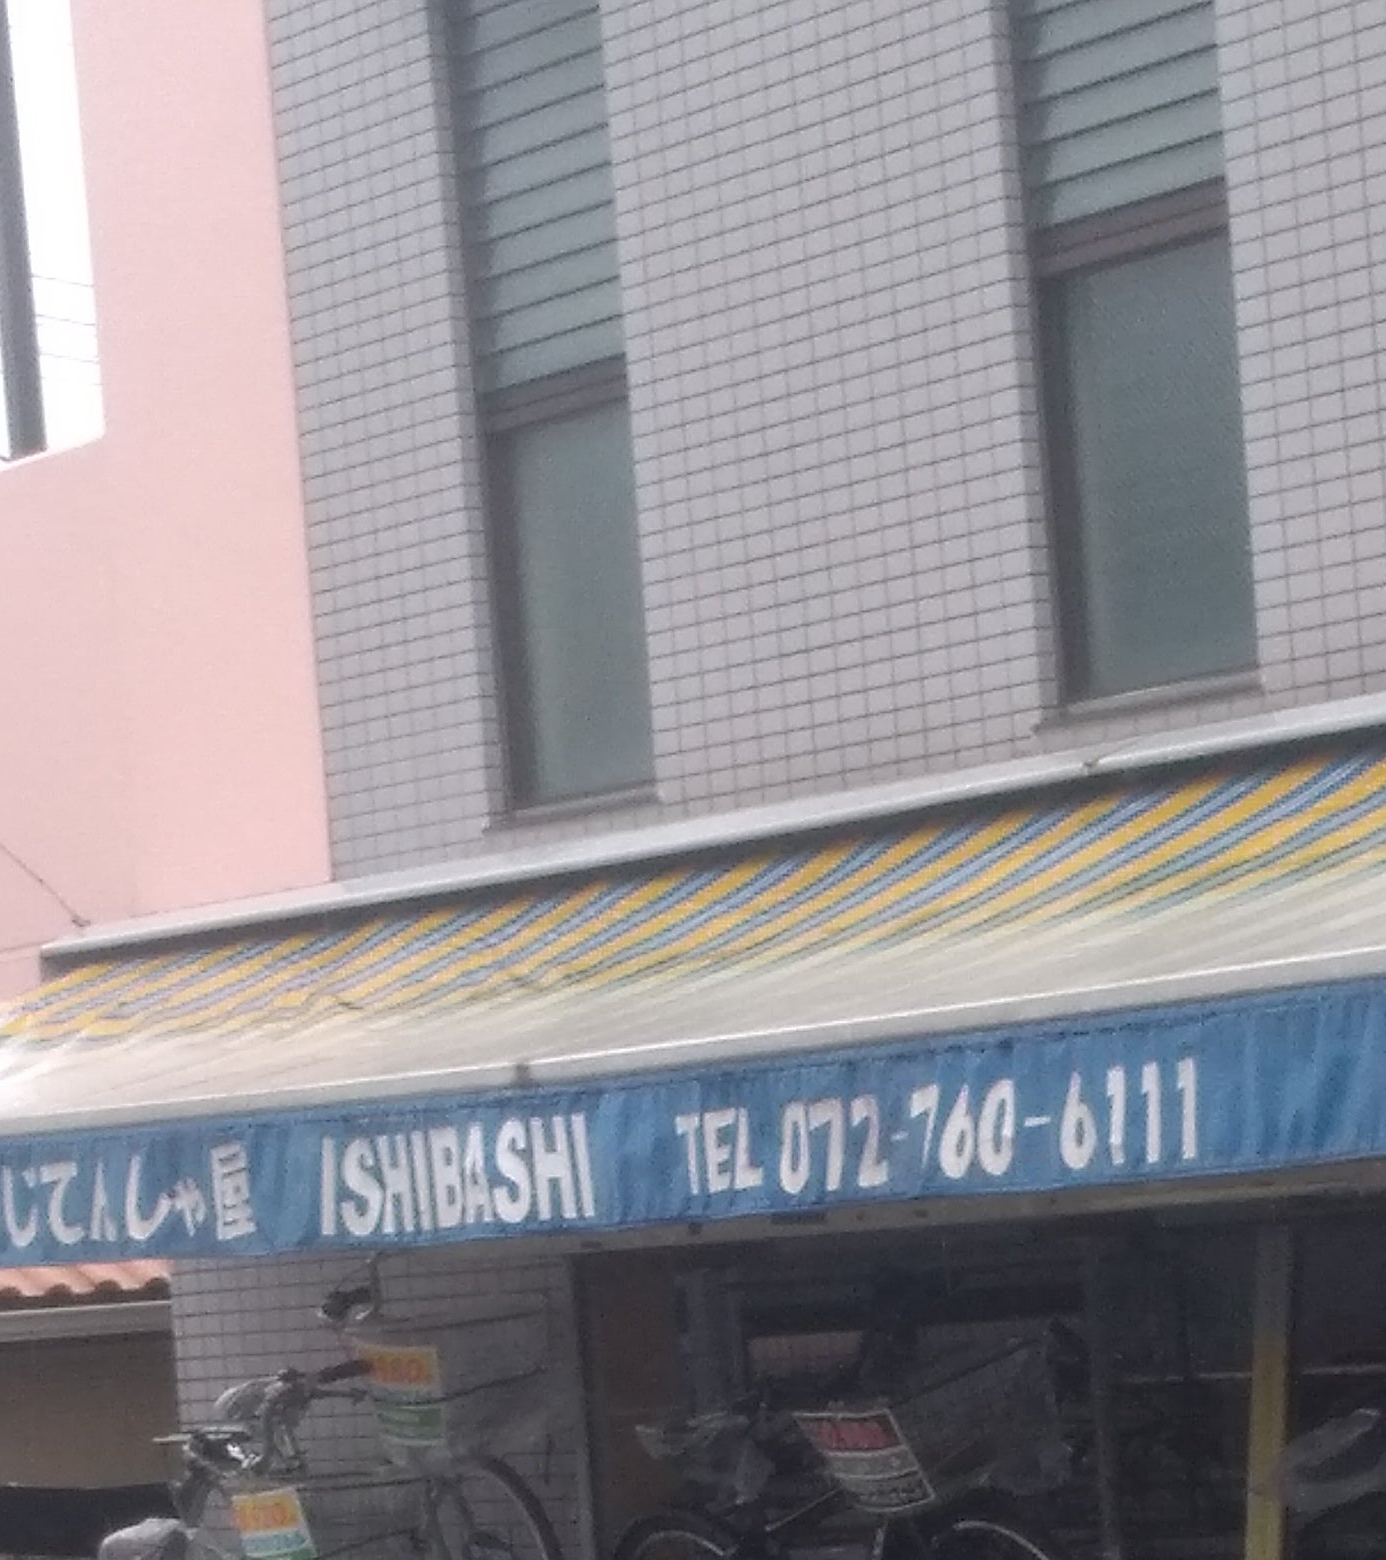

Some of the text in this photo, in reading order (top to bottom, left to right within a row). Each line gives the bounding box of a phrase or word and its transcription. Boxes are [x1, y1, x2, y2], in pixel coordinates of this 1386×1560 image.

[321, 1111, 594, 1236] ISHIBASHI
[675, 1057, 1196, 1195] TEL 072-760-6111
